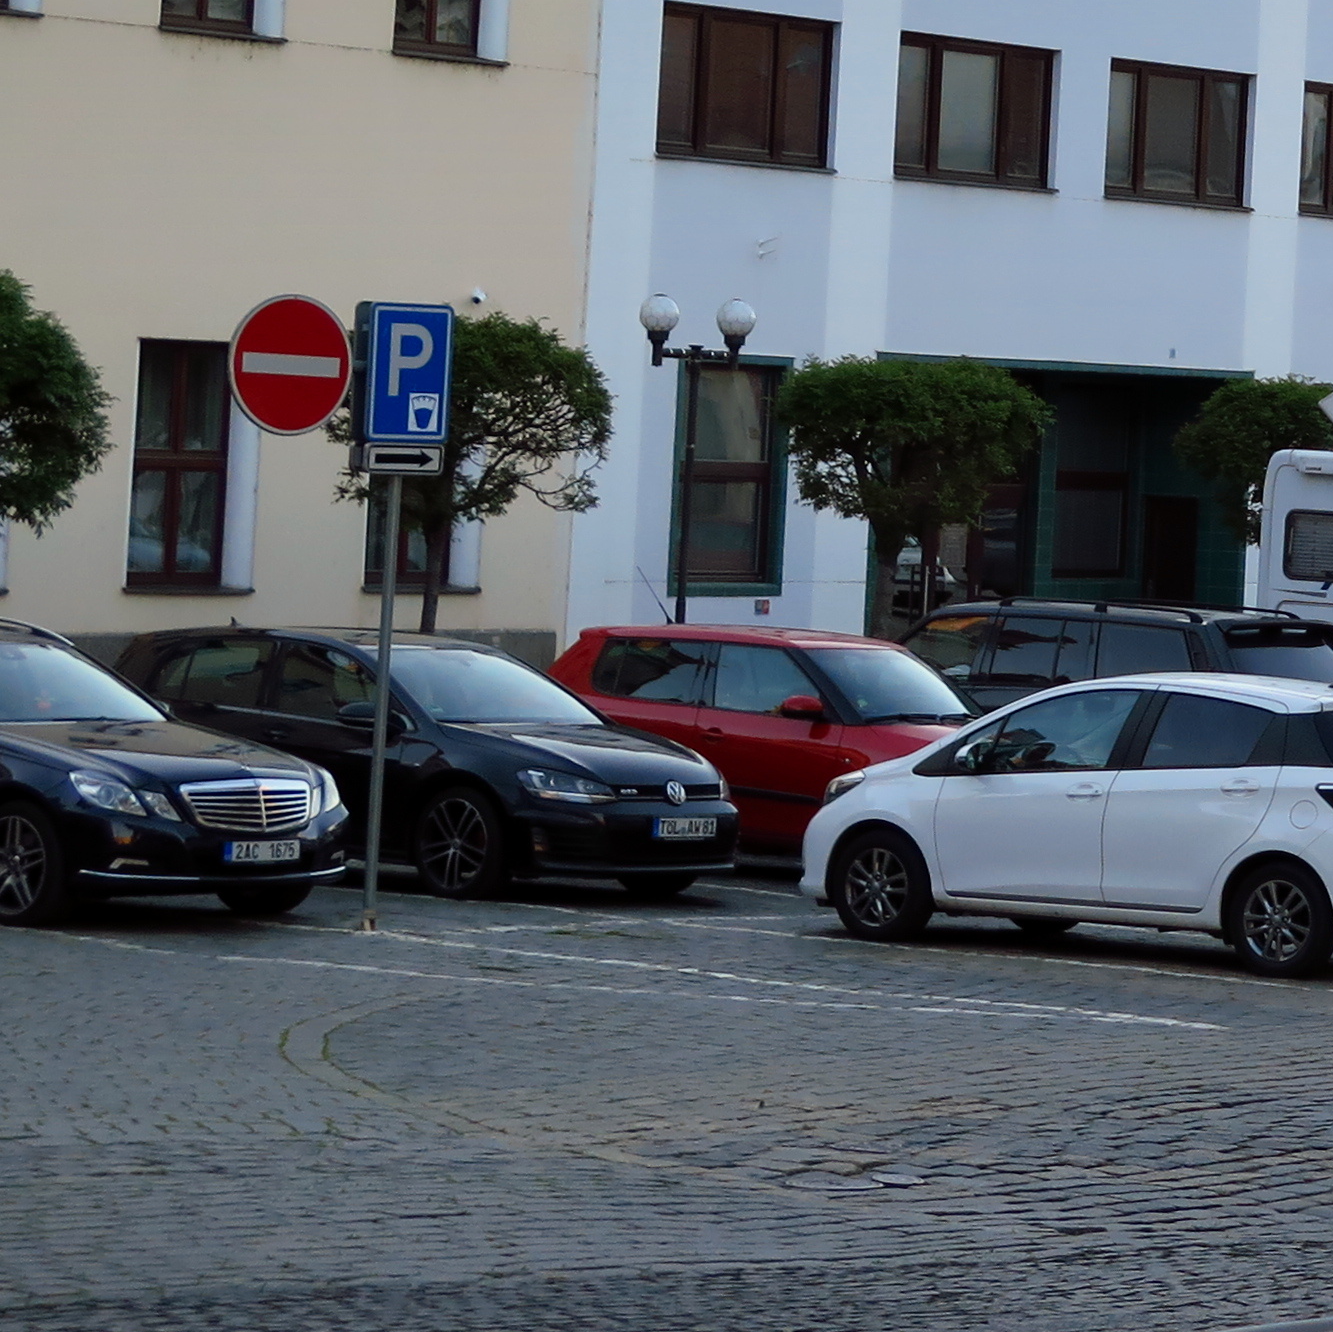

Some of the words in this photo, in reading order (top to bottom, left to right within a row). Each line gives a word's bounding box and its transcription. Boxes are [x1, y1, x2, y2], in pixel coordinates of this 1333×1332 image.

[387, 322, 434, 396] P
[236, 843, 260, 859] 2AC
[269, 842, 295, 858] 1675
